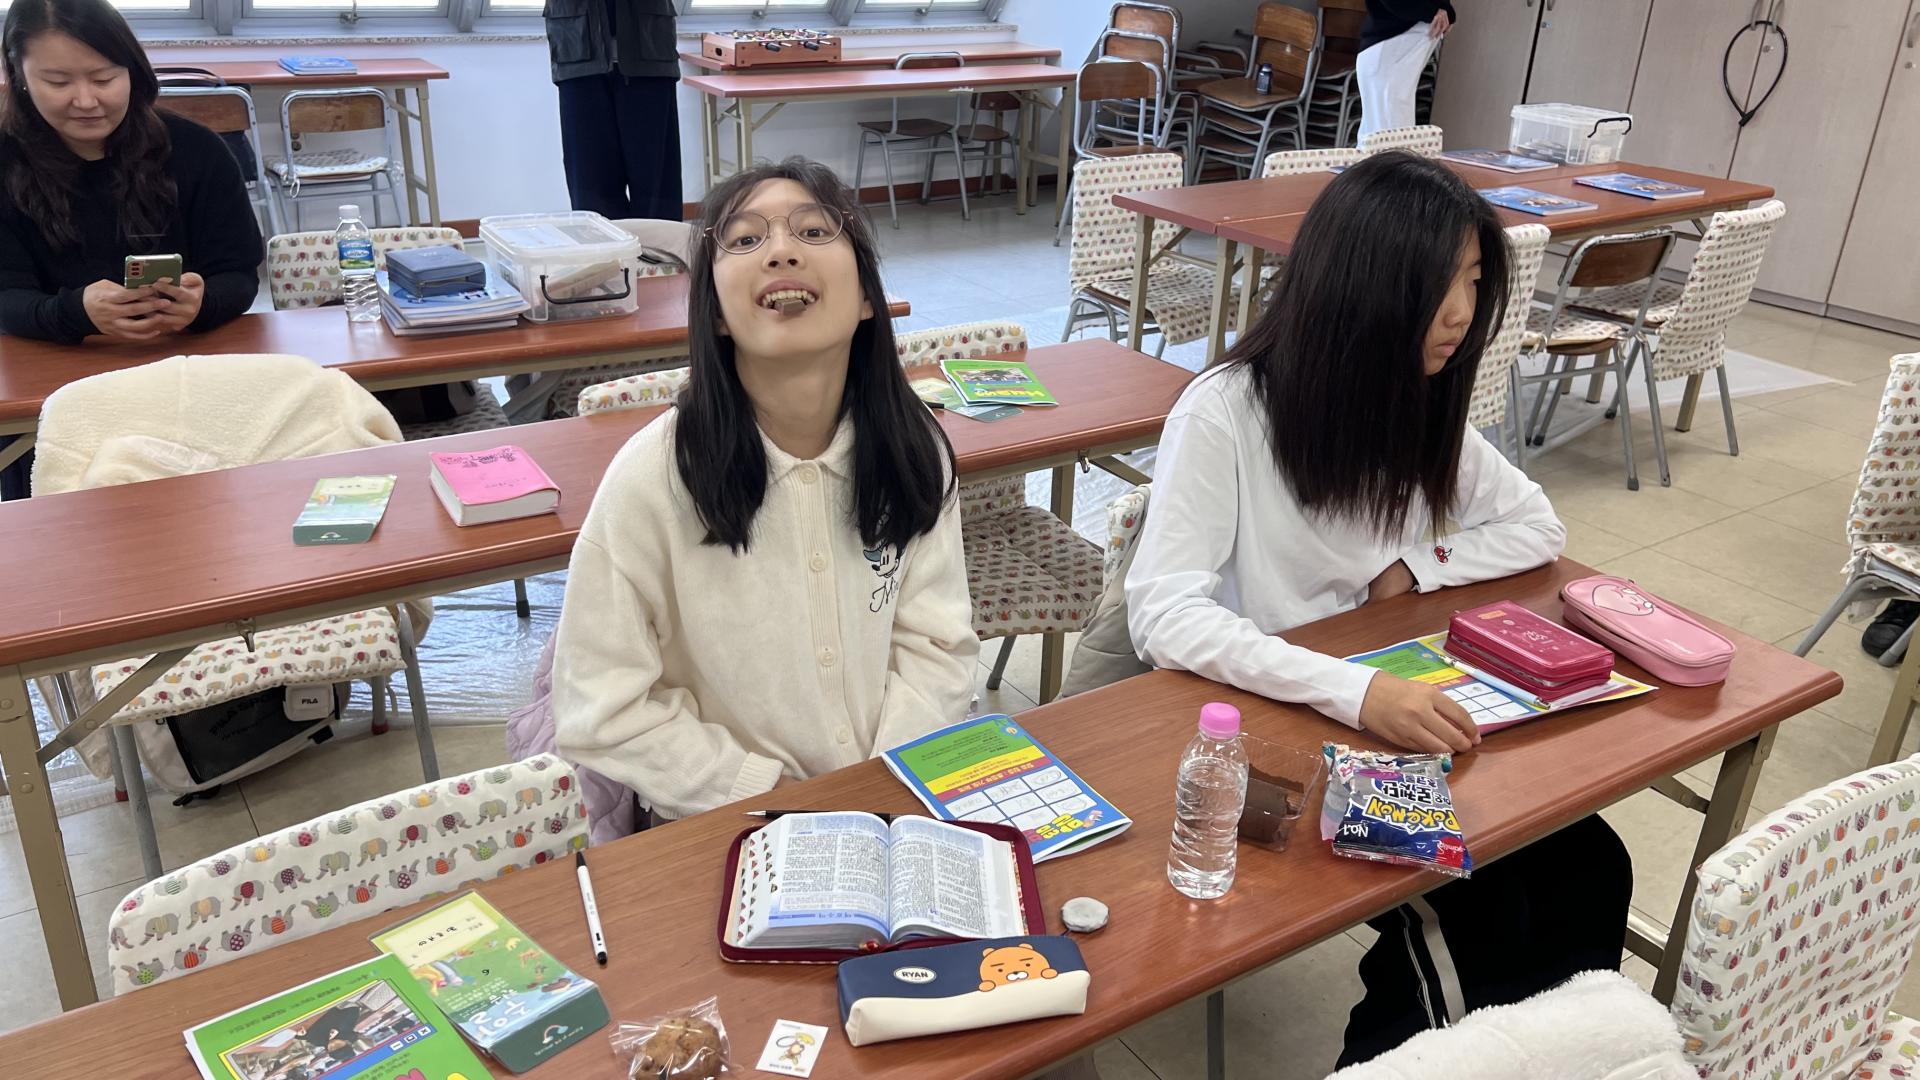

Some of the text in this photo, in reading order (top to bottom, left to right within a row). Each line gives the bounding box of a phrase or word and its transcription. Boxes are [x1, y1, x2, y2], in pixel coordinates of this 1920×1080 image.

[1383, 781, 1433, 804] 로켓단
[1342, 824, 1369, 838] No.1
[900, 970, 930, 979] RYAN
[467, 1000, 530, 1037] 주일
